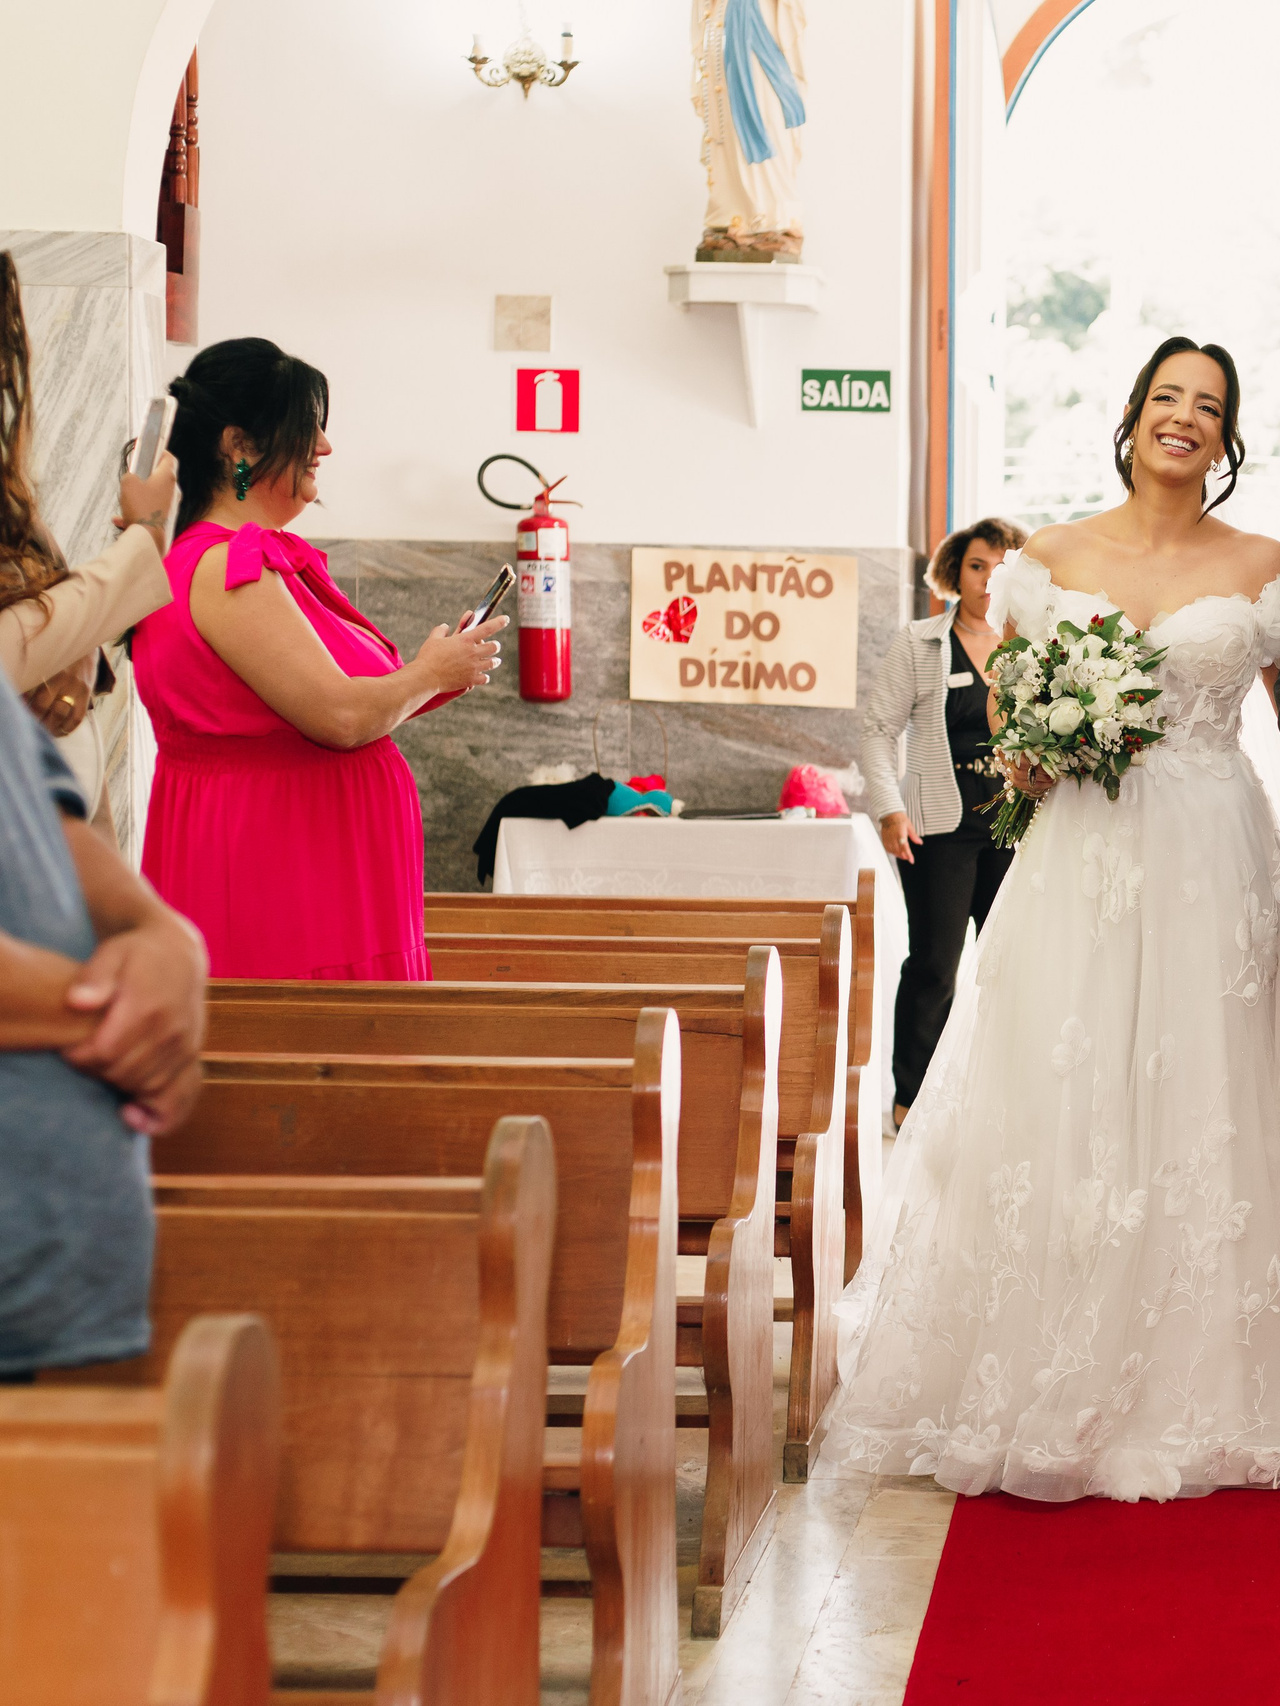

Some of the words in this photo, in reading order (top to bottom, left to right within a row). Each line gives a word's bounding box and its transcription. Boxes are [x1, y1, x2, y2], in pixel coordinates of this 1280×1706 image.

[802, 374, 890, 408] SAÍDA
[664, 556, 834, 599] PLANTÃO
[724, 609, 781, 642] DO
